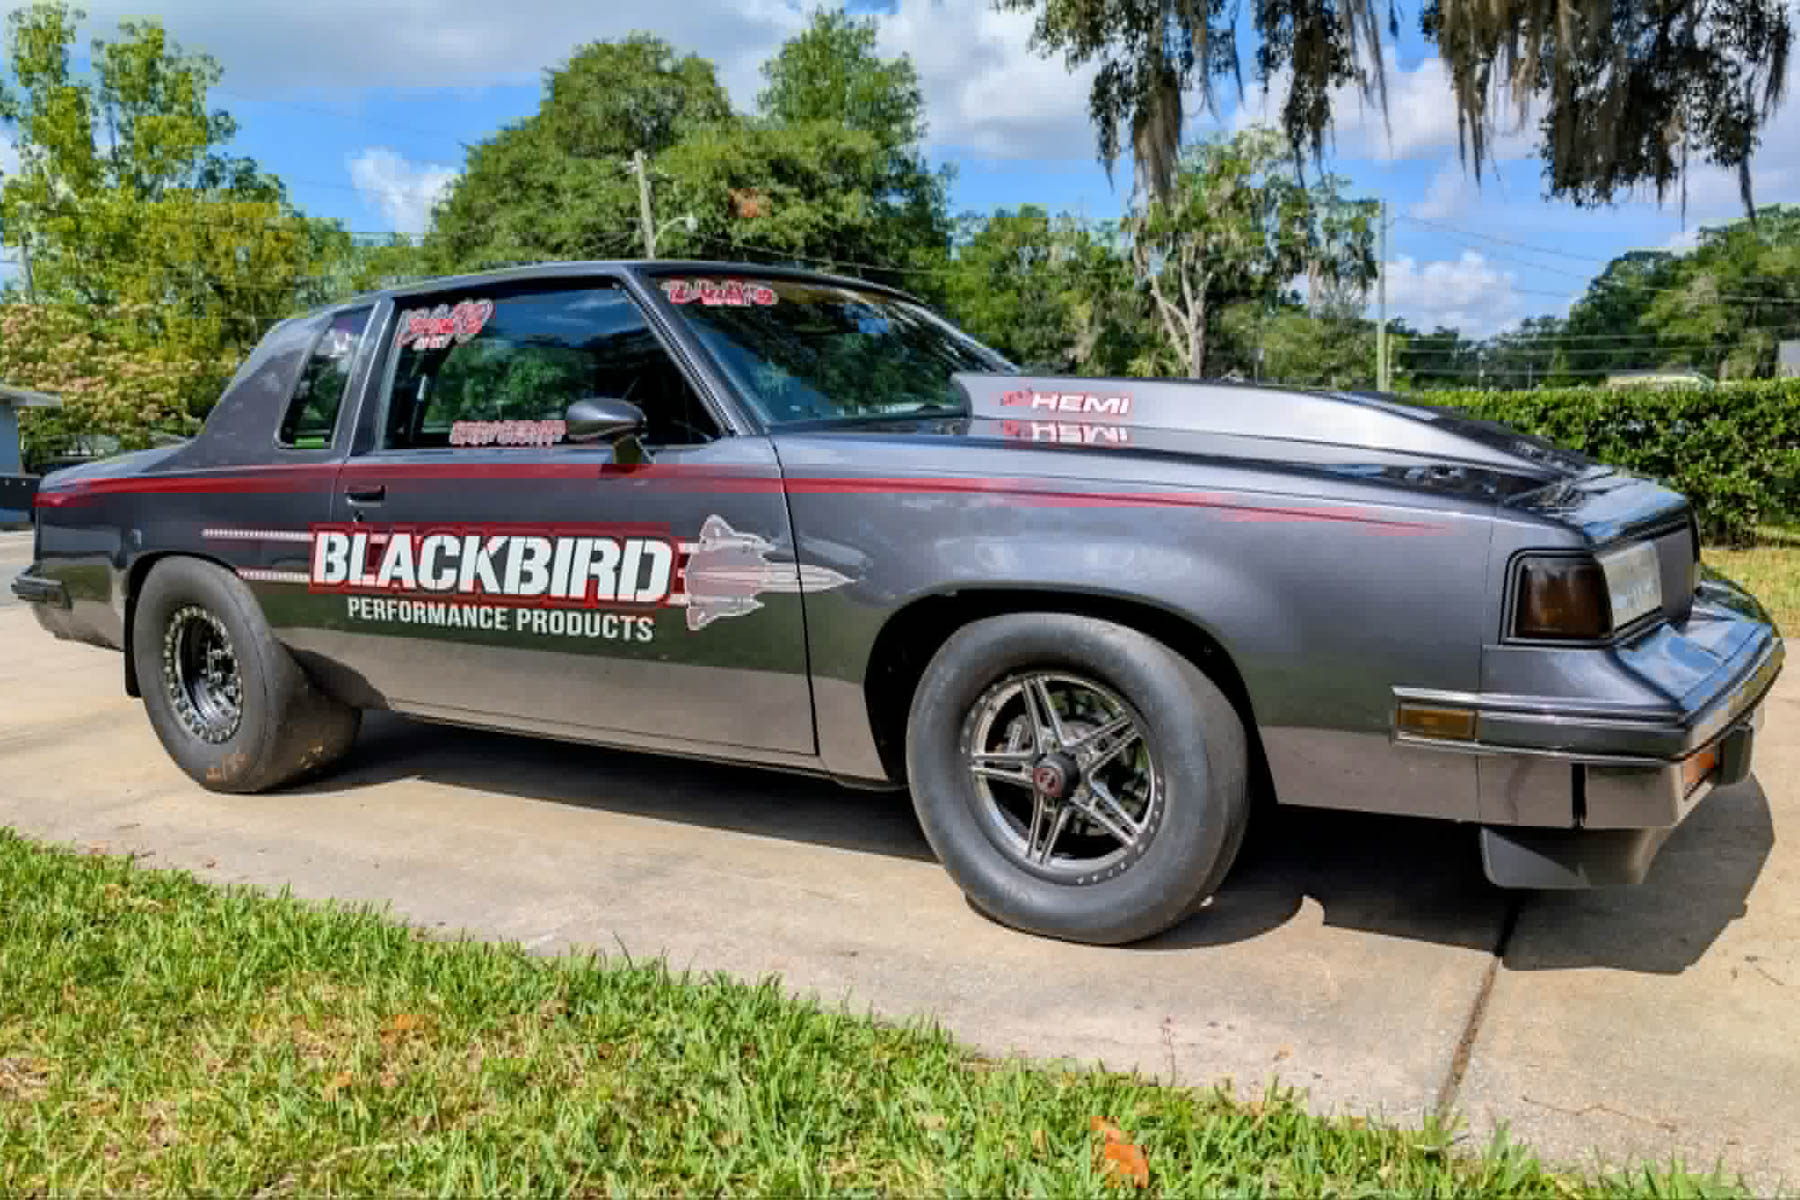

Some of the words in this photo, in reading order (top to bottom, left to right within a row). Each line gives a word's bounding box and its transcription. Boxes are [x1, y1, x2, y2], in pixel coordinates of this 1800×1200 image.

[1031, 393, 1129, 414] HEMI
[313, 530, 673, 603] BLACKBIRD
[347, 598, 510, 631] PERFORMANCE
[516, 608, 656, 642] PRODUCTS
